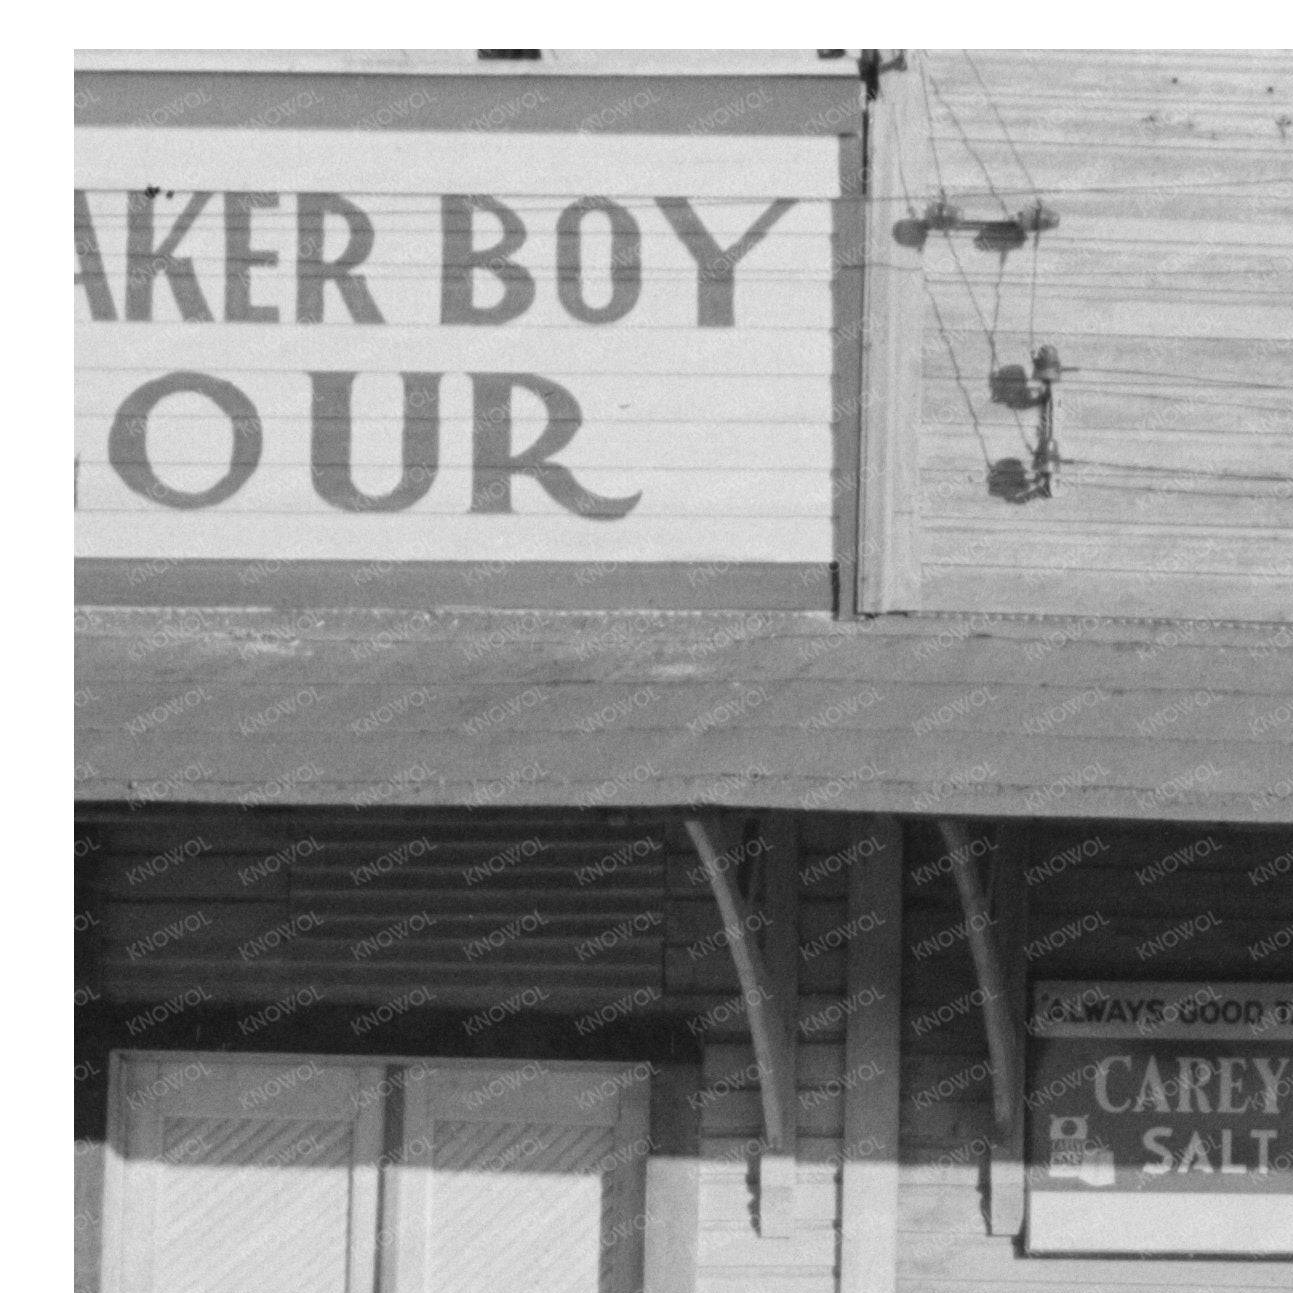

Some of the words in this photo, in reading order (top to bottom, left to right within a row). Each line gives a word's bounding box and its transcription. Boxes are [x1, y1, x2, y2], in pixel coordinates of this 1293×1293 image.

[440, 193, 801, 328] BOY
[74, 370, 643, 521] OUR
[1177, 999, 1266, 1026] GOOD
[1141, 1126, 1279, 1176] SALT
